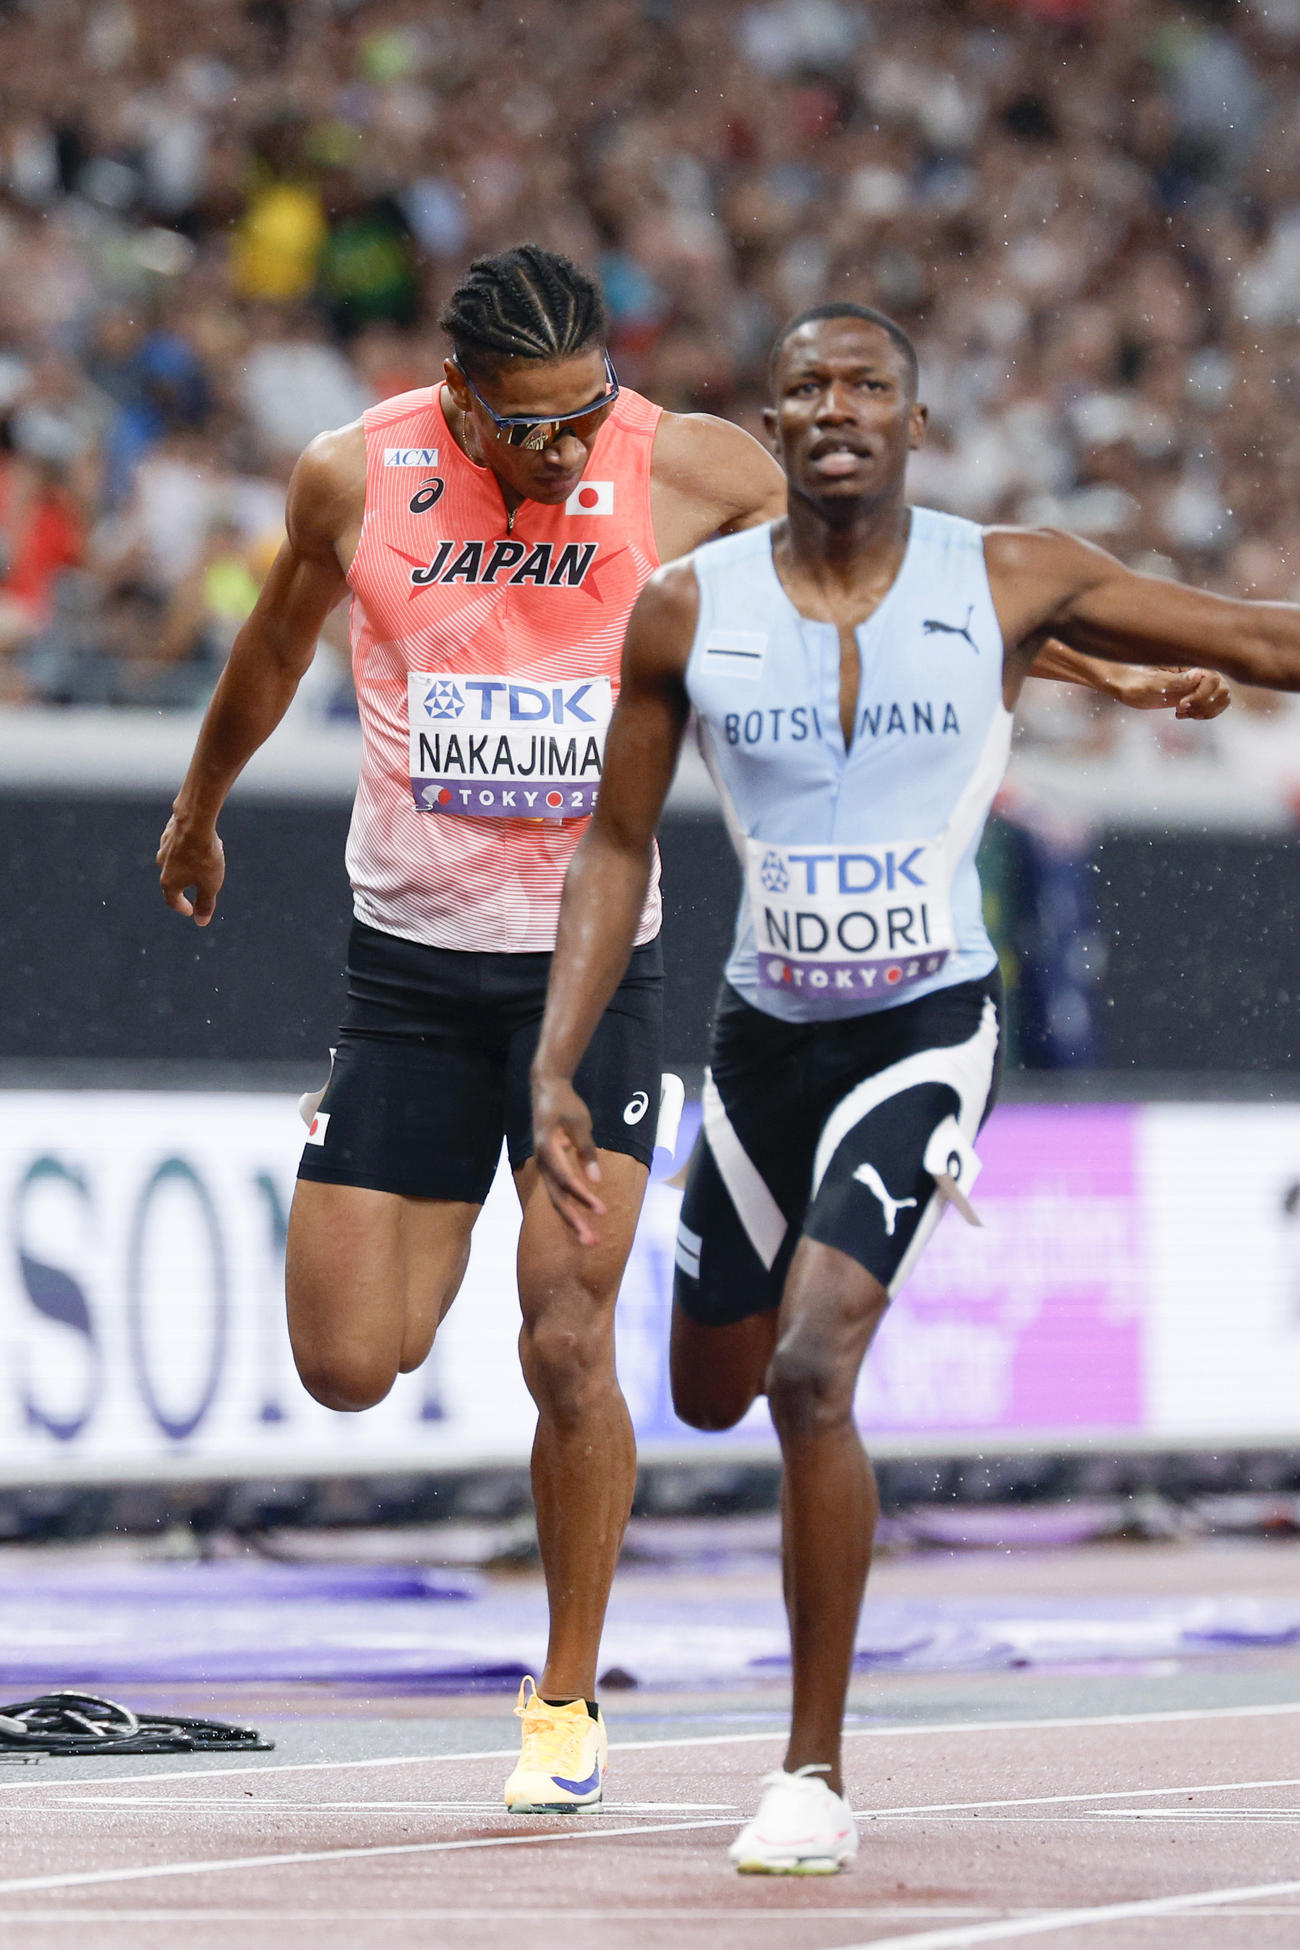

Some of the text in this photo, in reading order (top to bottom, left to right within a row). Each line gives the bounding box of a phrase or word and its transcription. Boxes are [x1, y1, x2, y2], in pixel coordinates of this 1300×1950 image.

[386, 449, 437, 465] ACN
[410, 540, 599, 587] JAPAN
[465, 681, 597, 725] TDK
[724, 701, 961, 746] BOTSWANA
[419, 732, 602, 777] NAKAJIMA
[788, 847, 928, 895] TDK
[764, 903, 931, 953] NDORI
